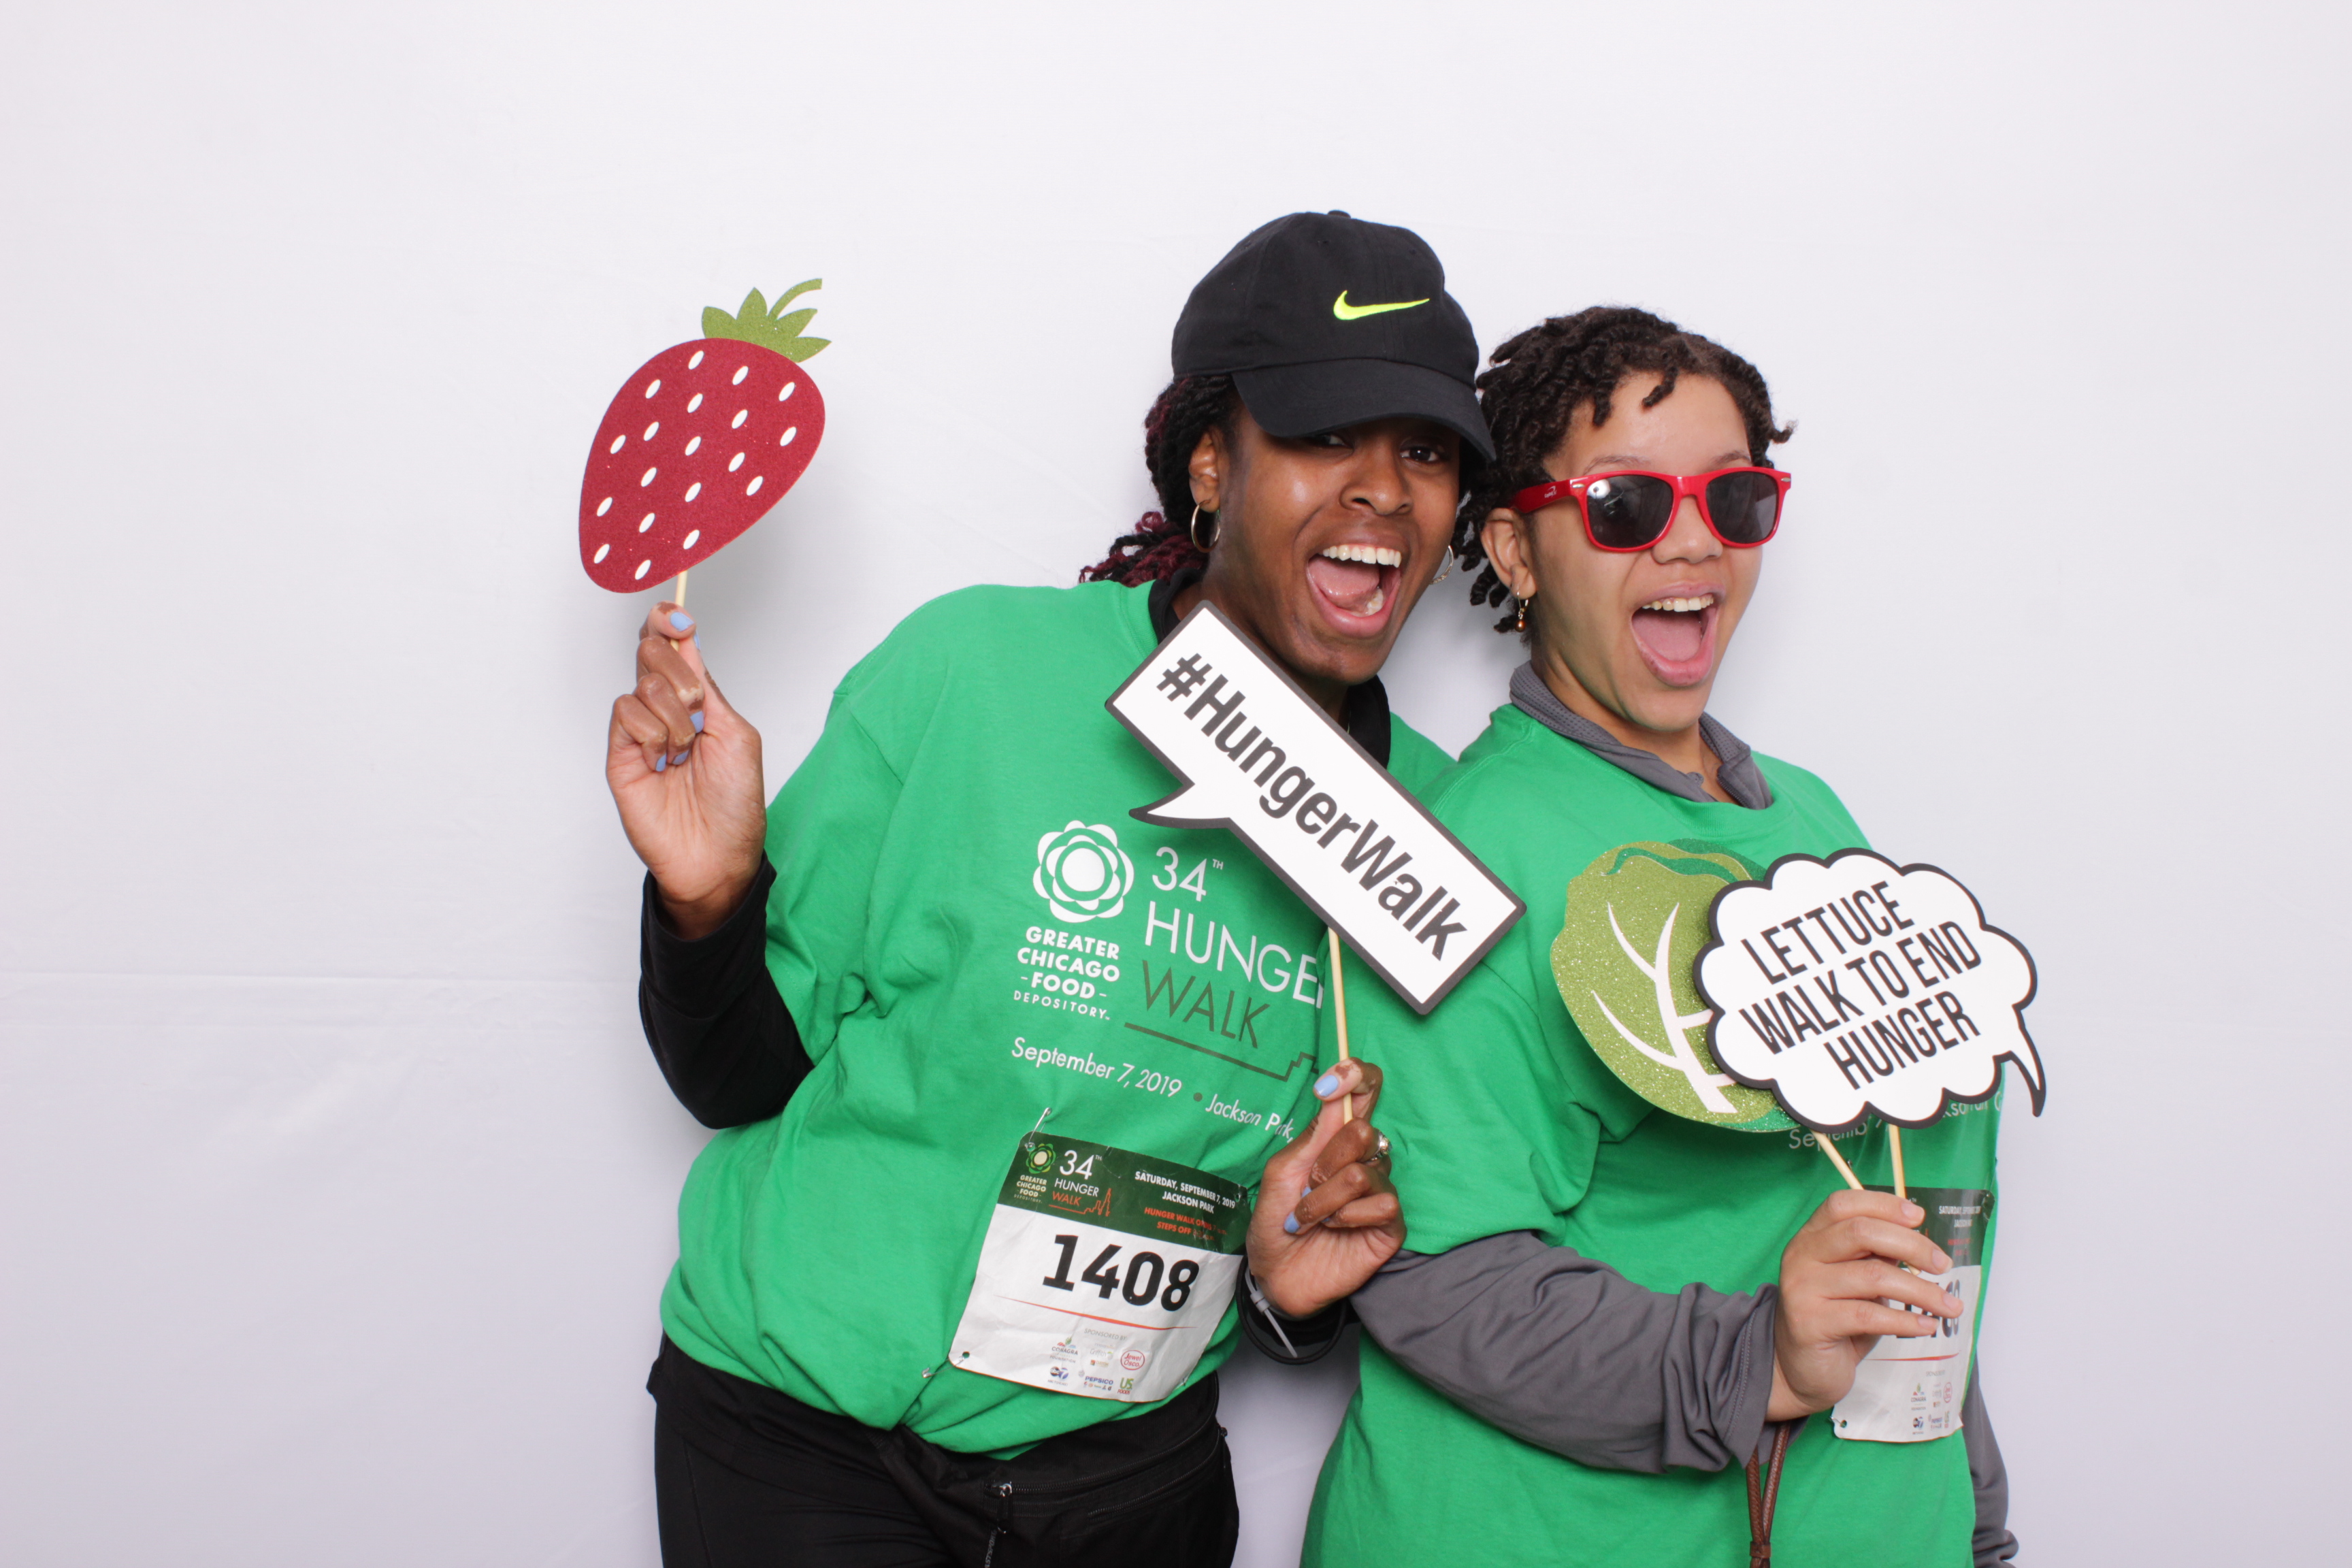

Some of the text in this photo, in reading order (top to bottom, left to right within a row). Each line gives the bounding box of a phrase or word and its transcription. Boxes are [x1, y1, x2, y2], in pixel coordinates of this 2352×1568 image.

[1156, 653, 1468, 961] #HungerWalk
[1026, 926, 1120, 960] GREATER
[1740, 880, 1915, 985] LETTUCE
[1017, 947, 1120, 982] CHICAGO
[1737, 921, 1982, 1055] WALK TO END
[1142, 959, 1271, 1049] WALK
[1823, 990, 1982, 1090] HUNGER
[1011, 1036, 1115, 1079] September
[1116, 1062, 1135, 1088] 7,
[1135, 1068, 1183, 1098] 2019
[1205, 1094, 1262, 1126] Jackson
[1016, 1181, 1047, 1192] CHICAGO
[1020, 1175, 1047, 1186] GREATER
[1054, 1177, 1100, 1198] HUNGER
[1134, 1171, 1178, 1191] SATURDAY,
[1180, 1182, 1216, 1201] SEPTEMBER
[1222, 1197, 1236, 1209] 2019
[1019, 1188, 1039, 1197] FOOD
[1051, 1191, 1082, 1207] WALK
[1162, 1191, 1215, 1214] JACKSON PARK
[1144, 1207, 1175, 1220] HUNGER
[1176, 1213, 1195, 1225] WALK
[1156, 1222, 1177, 1232] STEPS
[1177, 1226, 1192, 1235] OFF
[1042, 1234, 1200, 1312] 1408
[1084, 1328, 1119, 1340] SPONSORED
[1051, 1346, 1079, 1356] CONAGRA
[1124, 1352, 1142, 1362] Jewel
